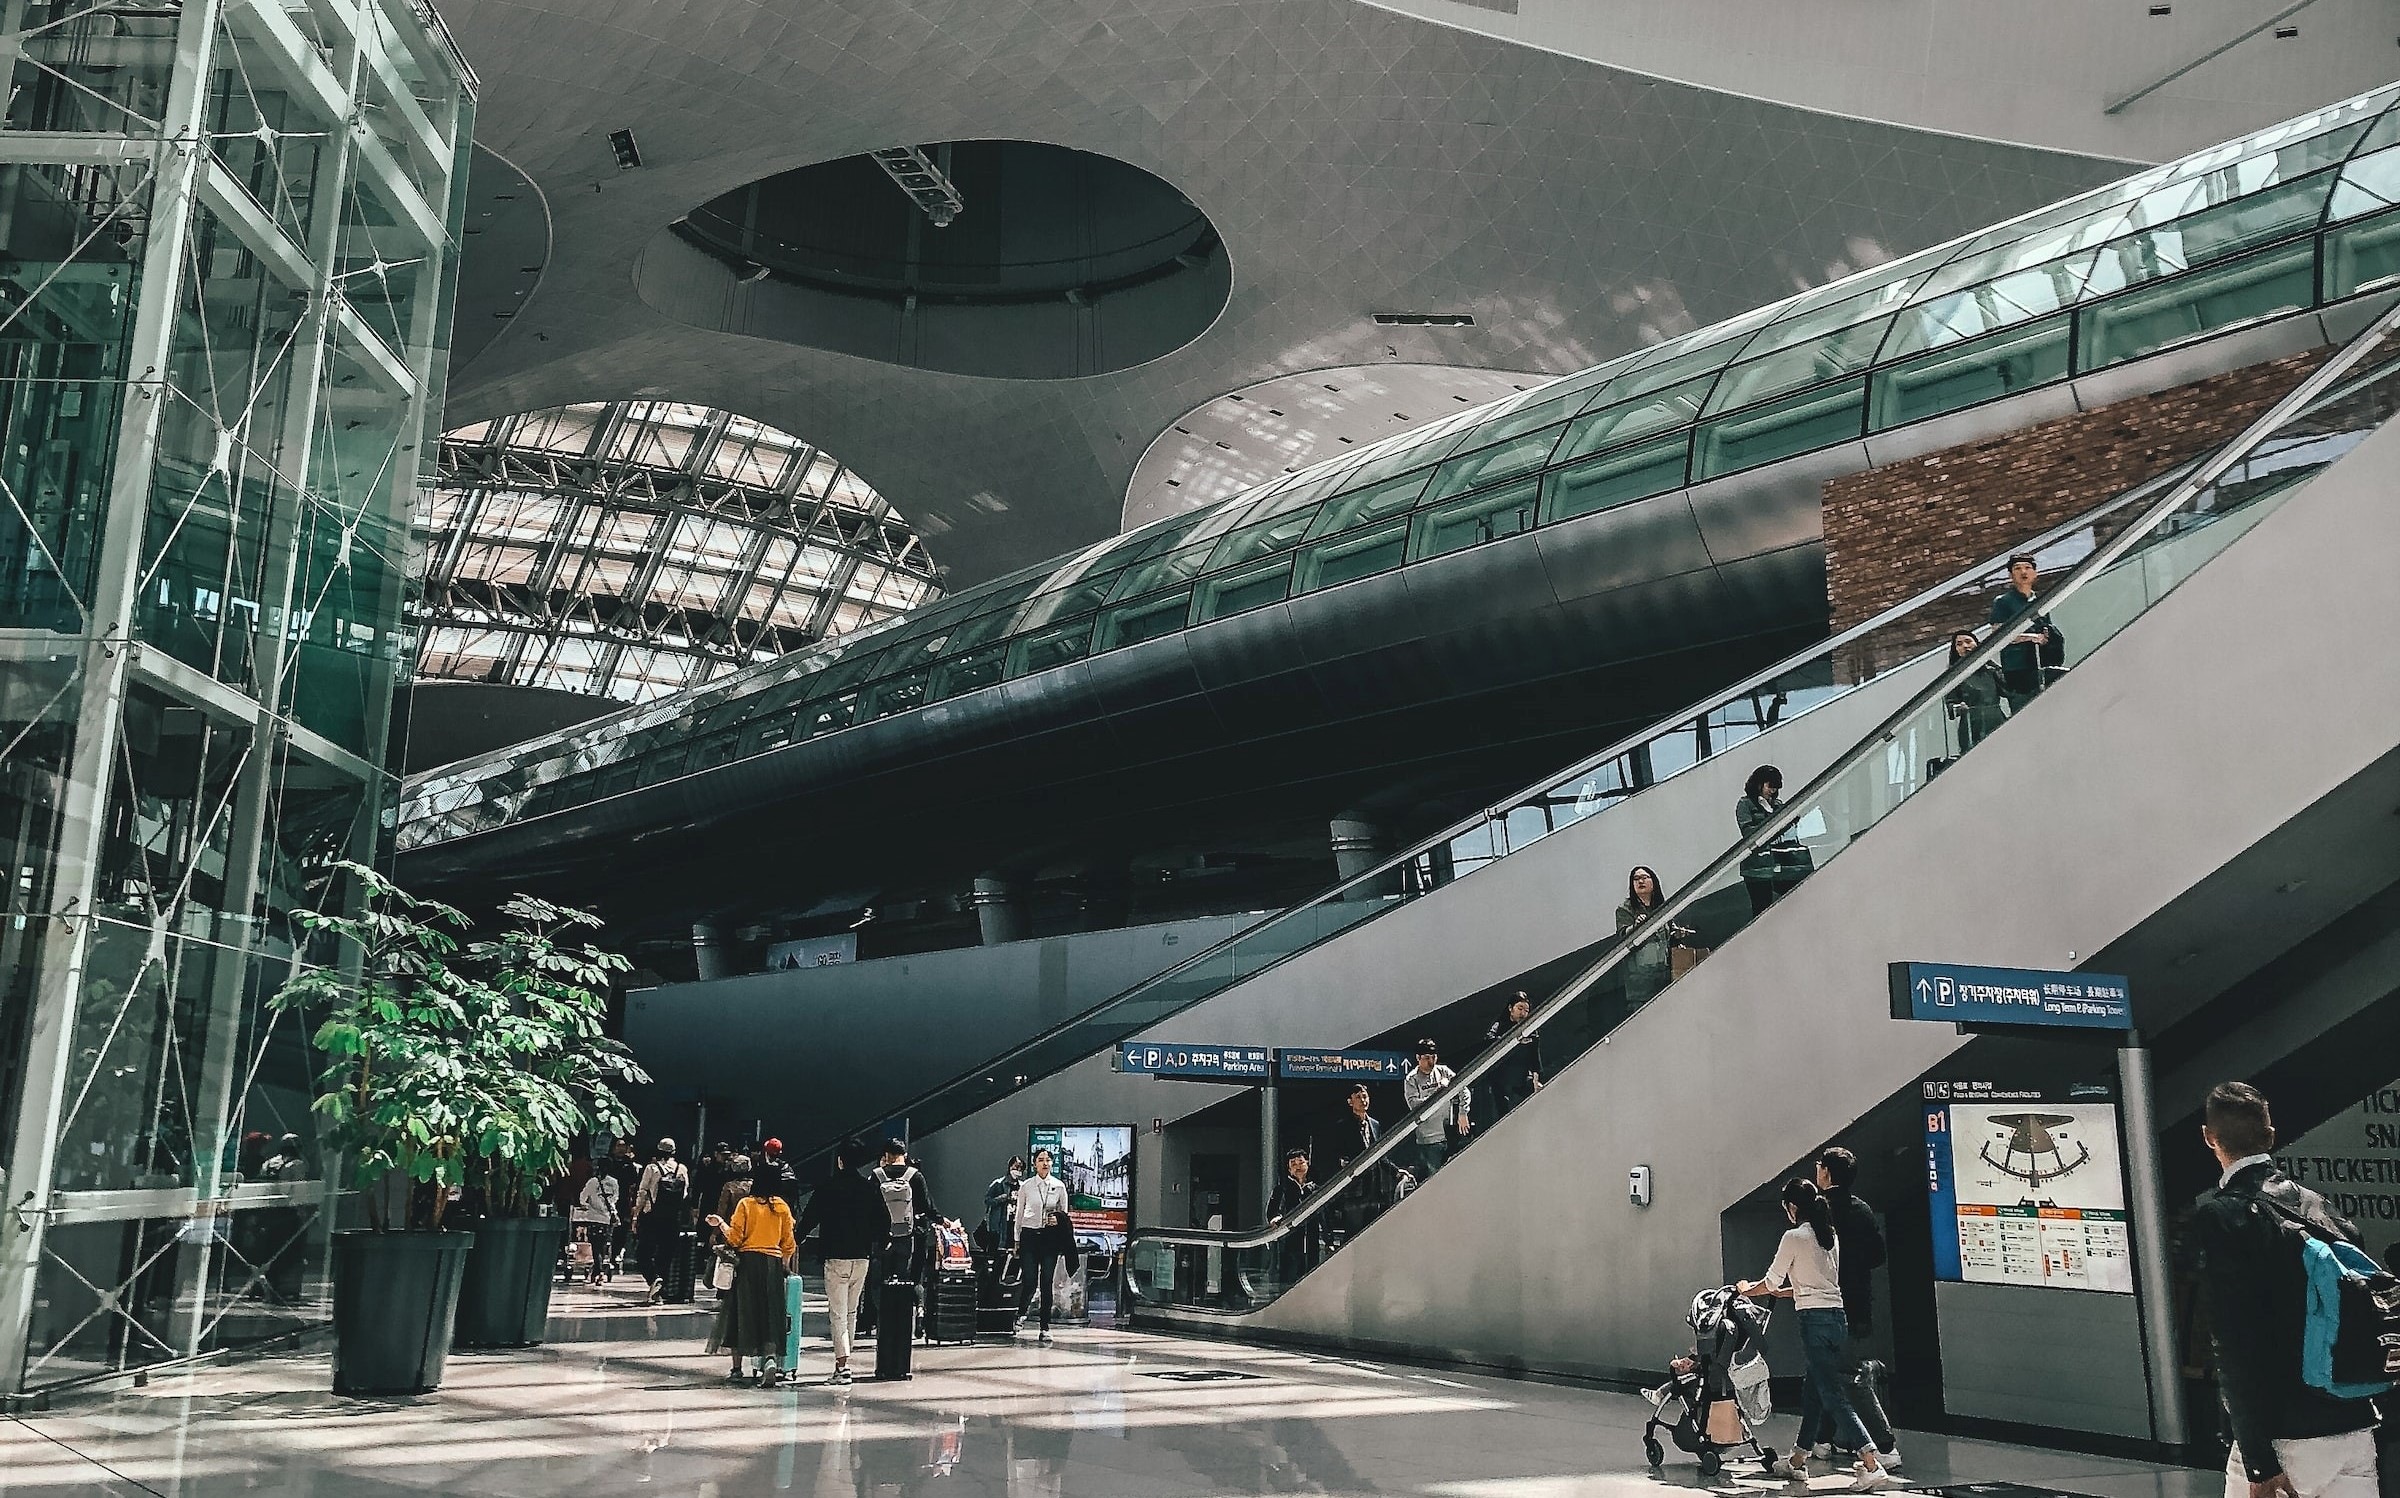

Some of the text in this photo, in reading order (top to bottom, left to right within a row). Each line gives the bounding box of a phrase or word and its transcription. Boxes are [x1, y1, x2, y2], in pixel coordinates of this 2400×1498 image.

[1223, 1062, 1265, 1074] Parking Area
[1927, 1110, 1946, 1133] B1
[2364, 1123, 2400, 1149] SN
[2275, 1156, 2308, 1181] ELF
